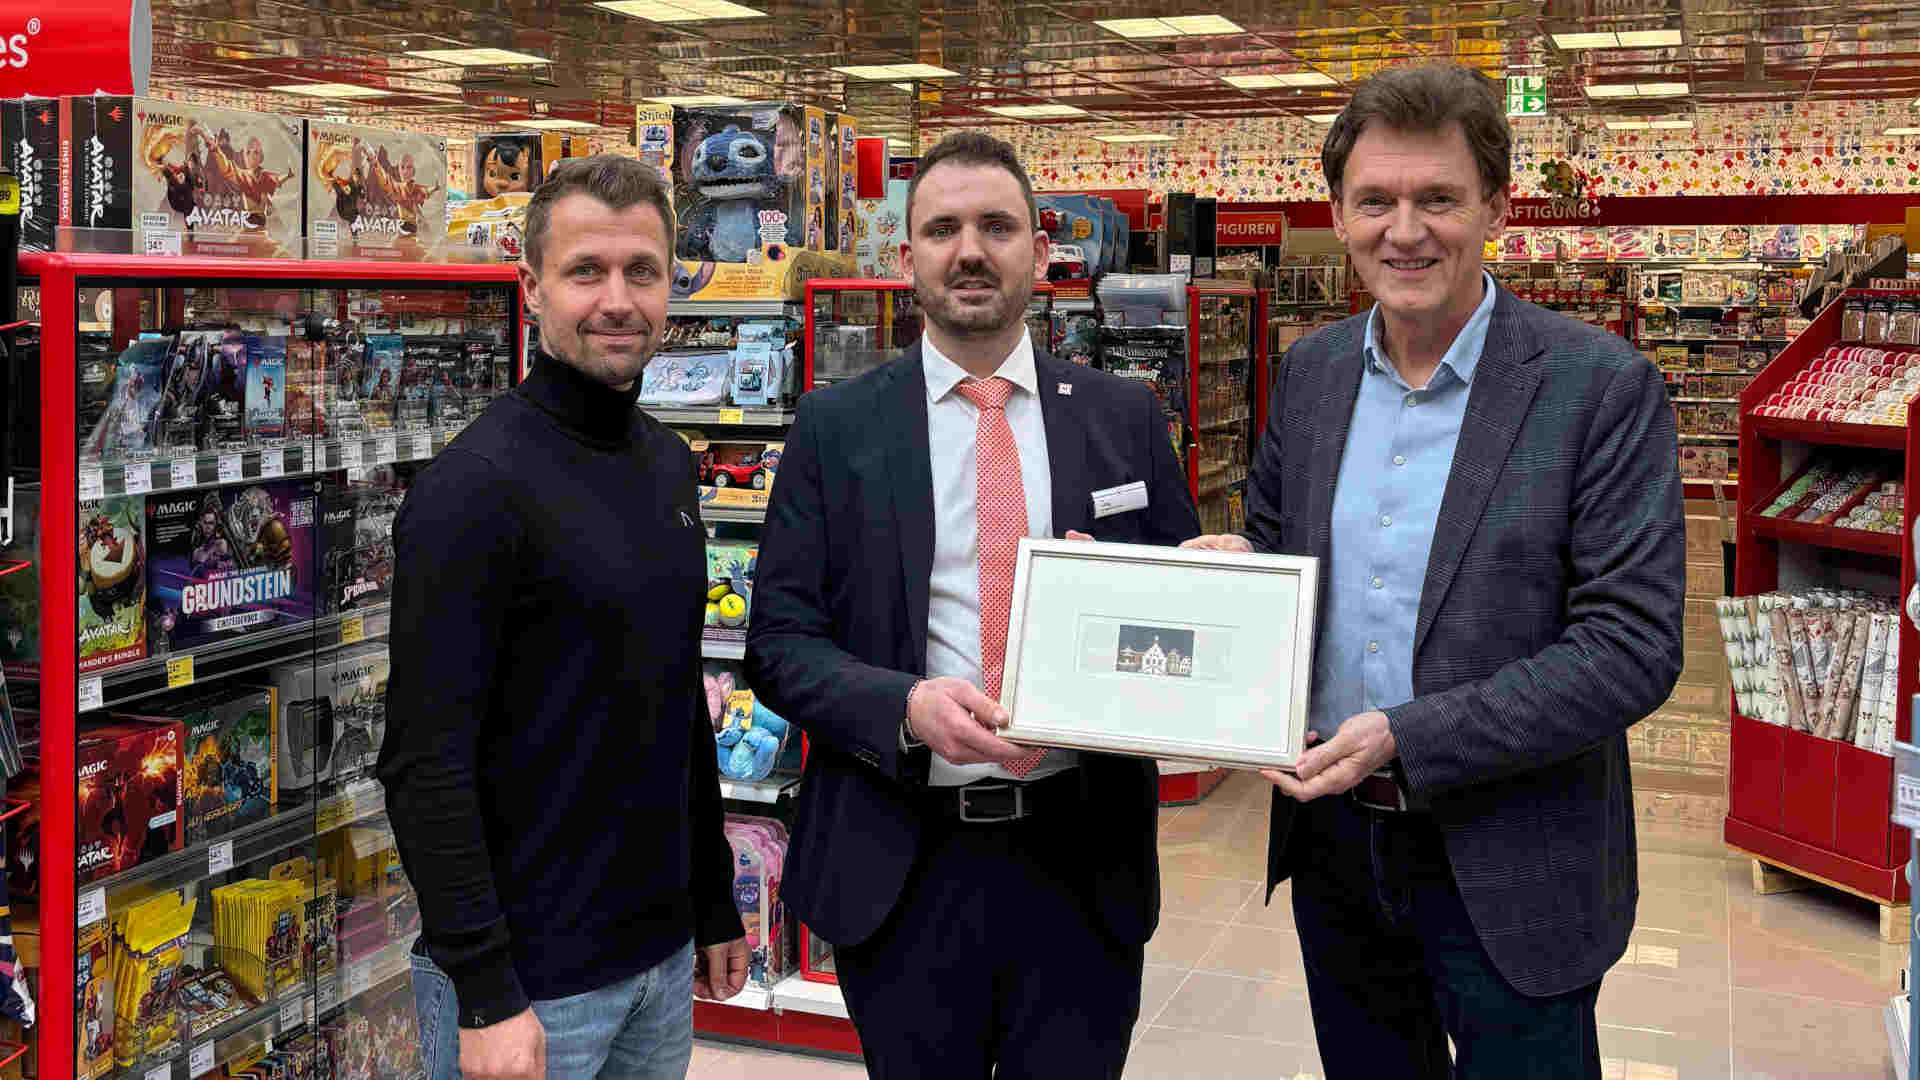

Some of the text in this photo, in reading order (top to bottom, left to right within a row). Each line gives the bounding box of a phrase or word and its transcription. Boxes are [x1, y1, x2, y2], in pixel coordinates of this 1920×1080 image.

[145, 113, 184, 126] MAGIC
[319, 132, 351, 144] MAGIC
[19, 137, 34, 229] AVATAR
[90, 135, 105, 228] AVATAR
[186, 207, 259, 230] AVATAR
[351, 215, 410, 236] AVATAR
[158, 500, 197, 516] MAGIC
[182, 569, 291, 615] GRUNDSTEIN
[341, 664, 377, 681] MAGIC
[79, 759, 109, 777] AGIC
